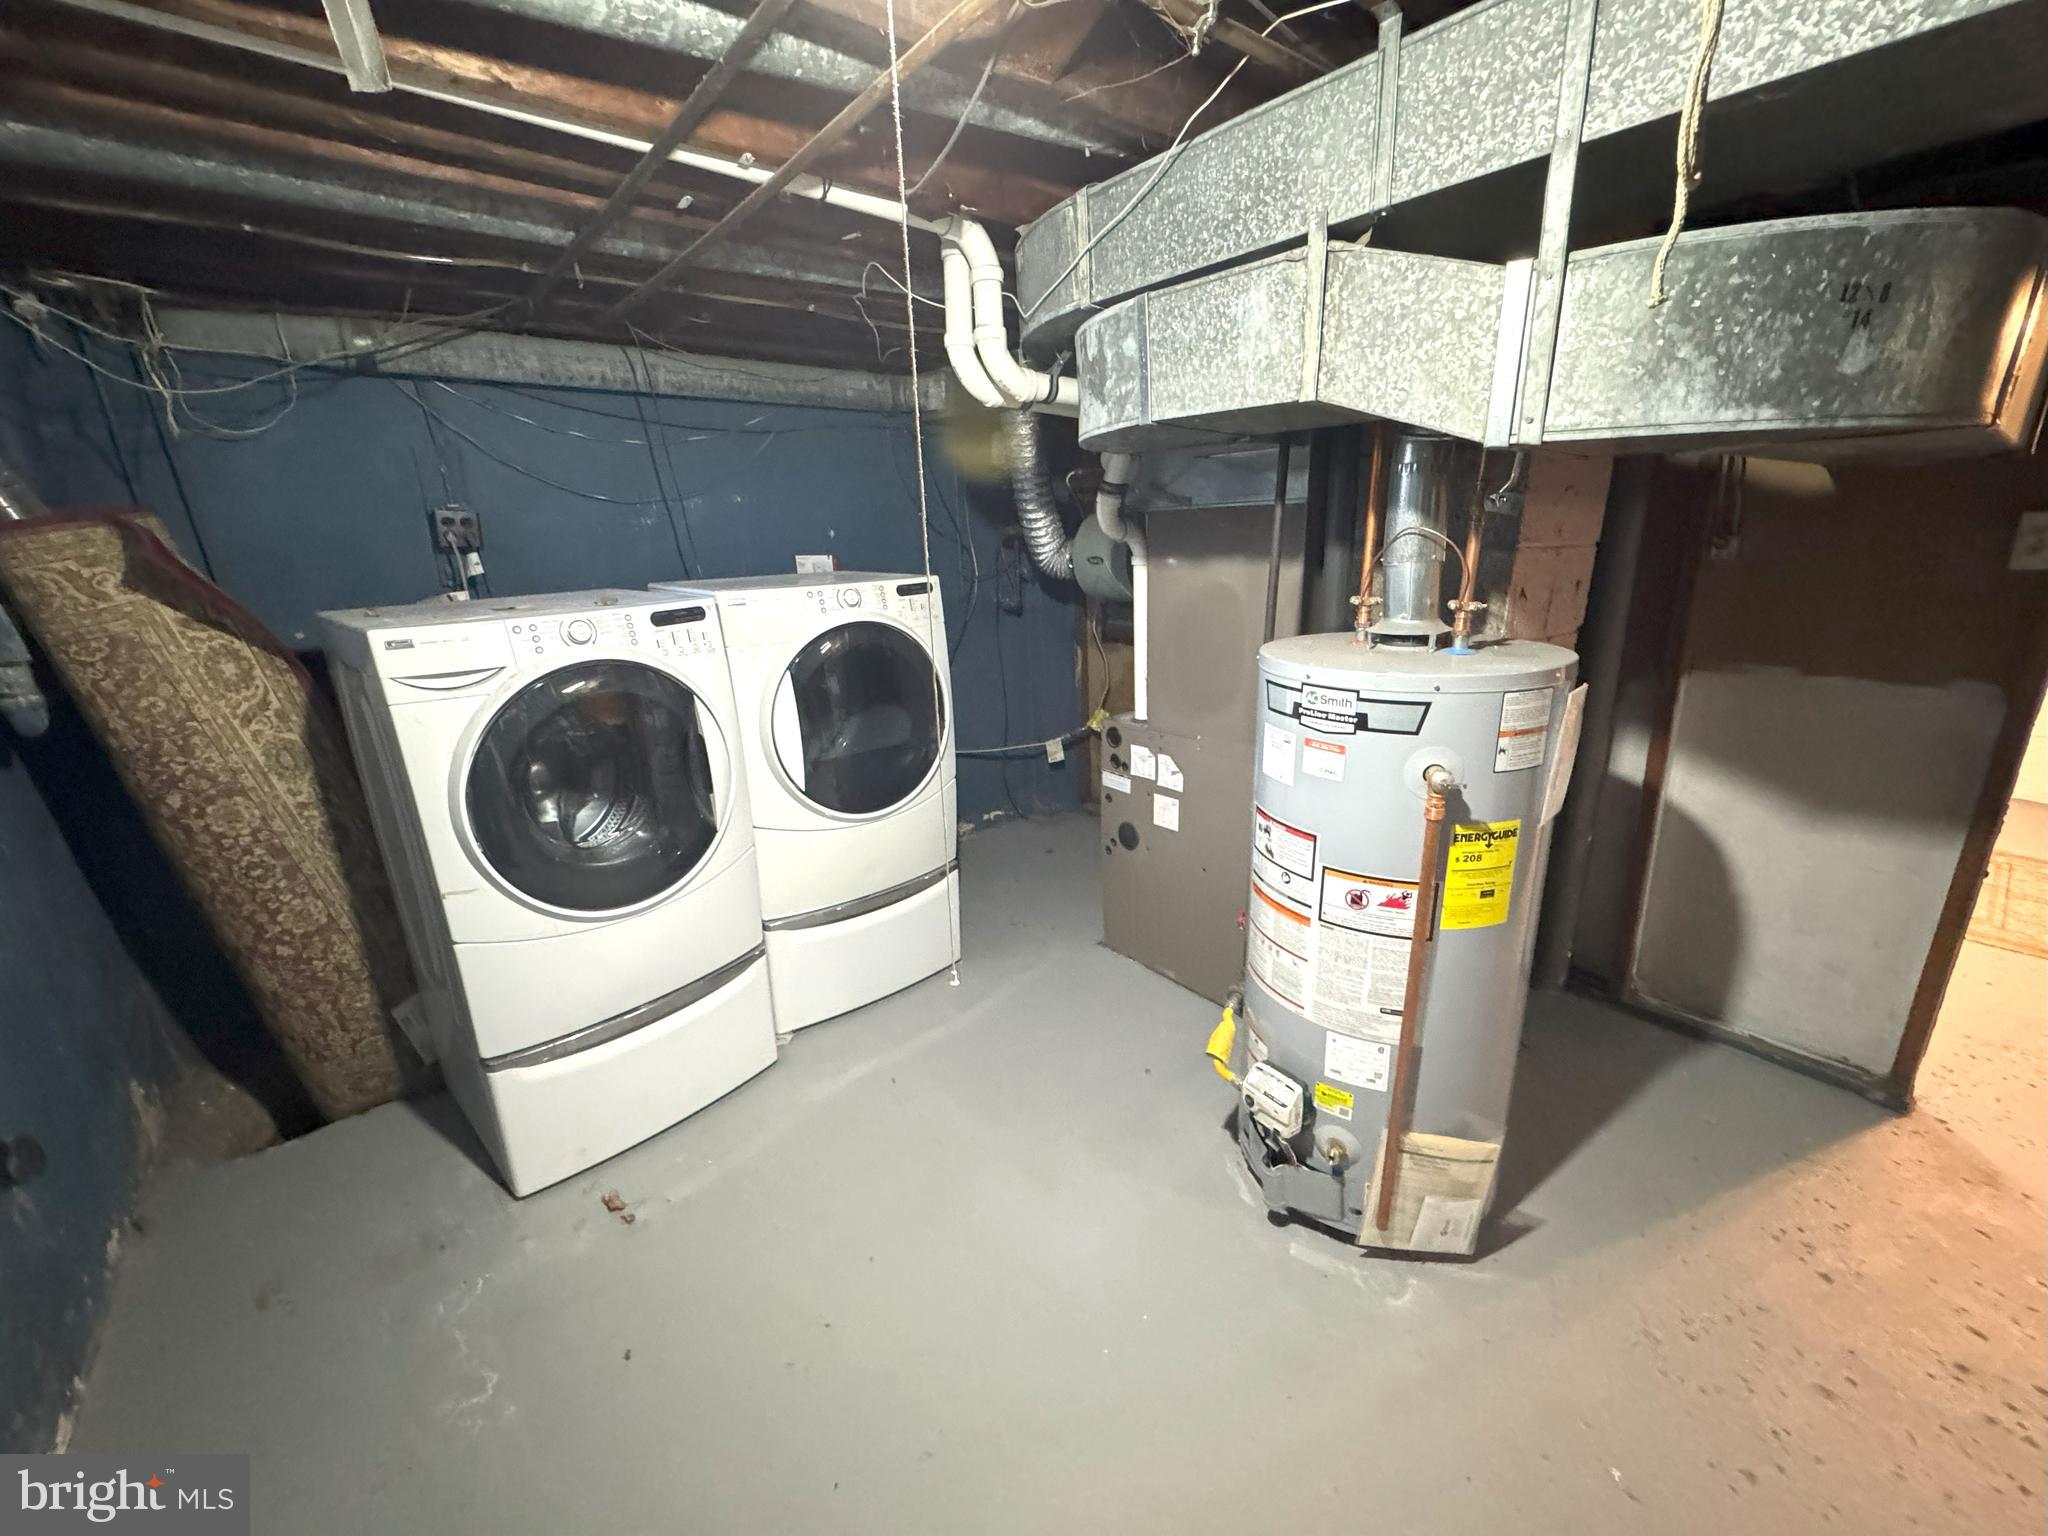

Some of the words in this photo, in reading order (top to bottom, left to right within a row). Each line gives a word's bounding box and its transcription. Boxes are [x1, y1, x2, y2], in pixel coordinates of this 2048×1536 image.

[1320, 694, 1353, 709] Smith
[1327, 712, 1359, 724] Master
[1462, 854, 1483, 863] 208
